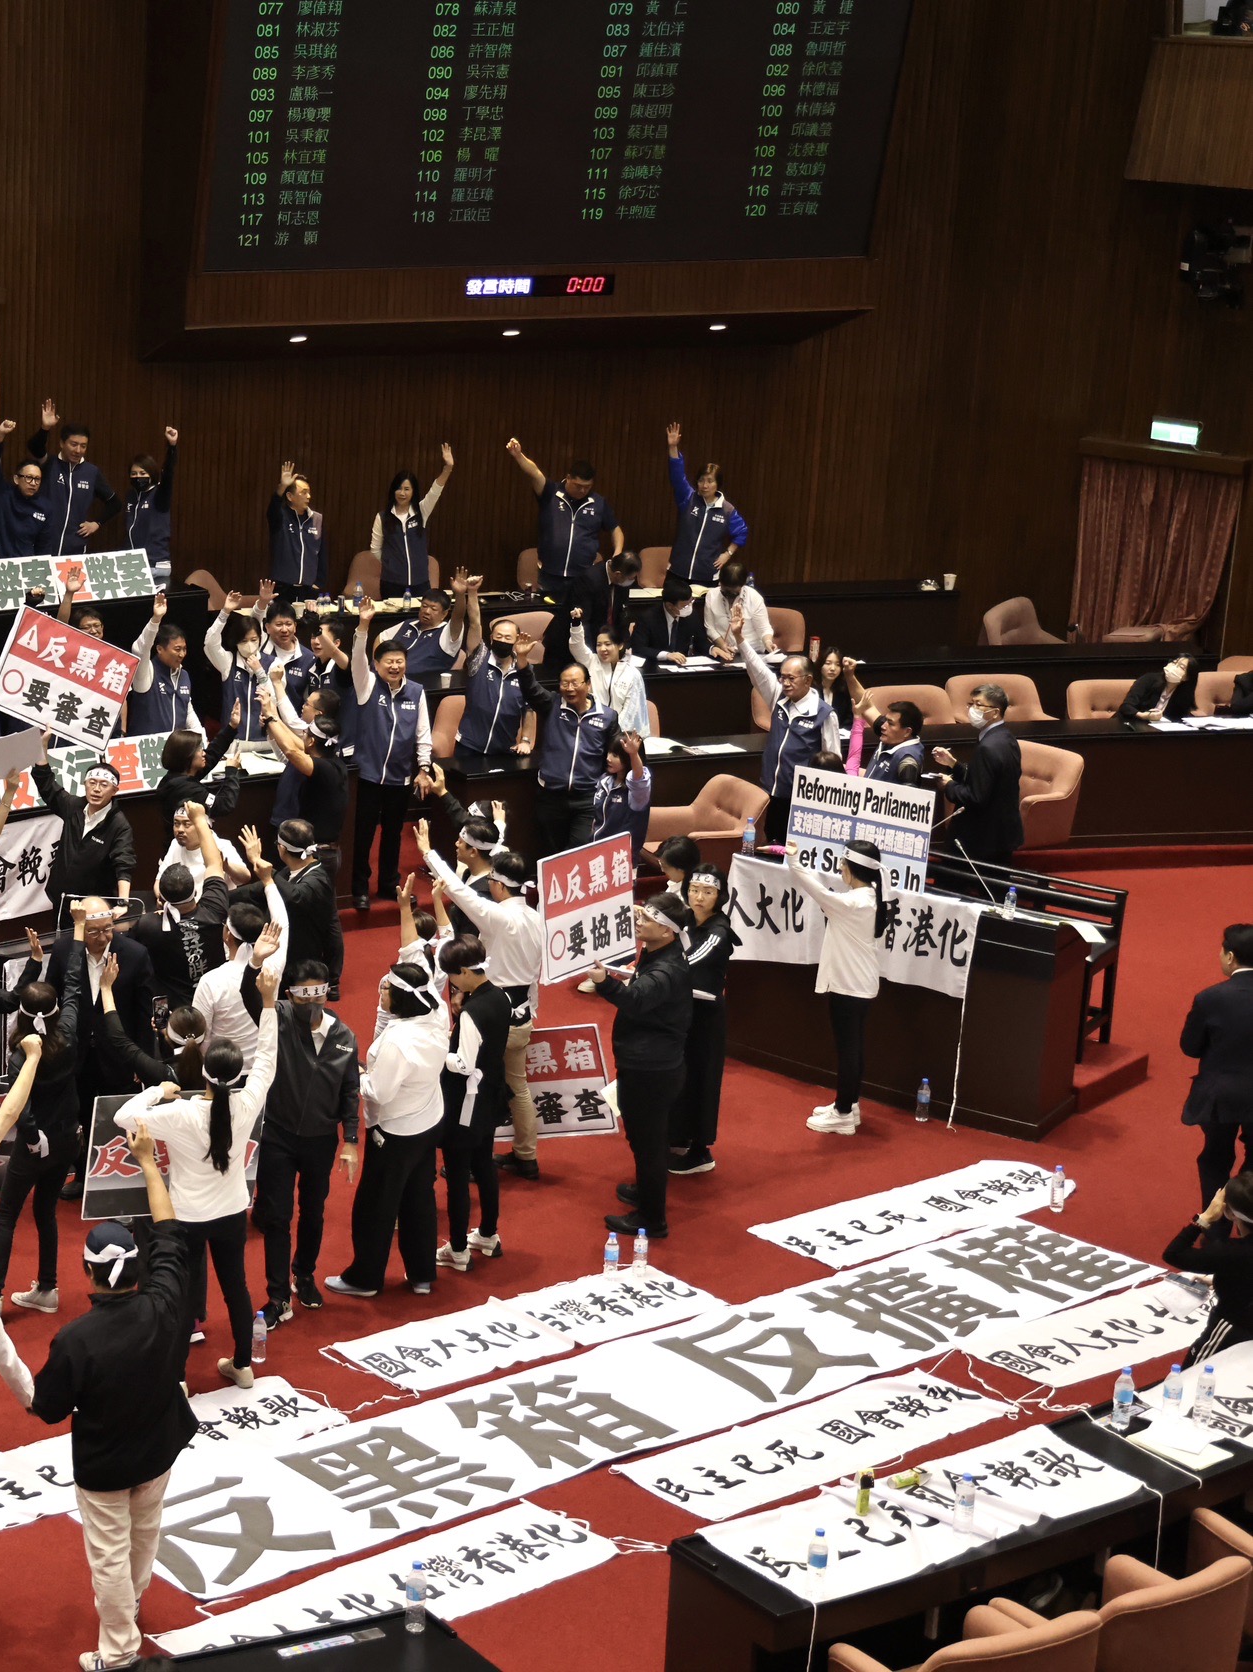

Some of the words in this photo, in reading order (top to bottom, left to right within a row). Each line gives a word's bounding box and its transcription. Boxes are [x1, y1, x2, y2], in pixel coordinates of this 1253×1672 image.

[259, 2, 283, 16] 077
[436, 3, 460, 17] 078
[609, 3, 633, 16] 079
[777, 2, 799, 15] 080
[257, 24, 281, 38] 081
[433, 25, 457, 38] 082
[606, 24, 630, 37] 083
[773, 23, 796, 36] 084
[255, 46, 279, 59] 085
[431, 46, 455, 59] 086
[603, 45, 627, 58] 087
[770, 44, 792, 57] 088
[253, 68, 277, 81] 089
[429, 67, 452, 80] 090
[601, 66, 624, 78] 091
[767, 64, 789, 77] 092
[251, 89, 274, 102] 093
[426, 88, 450, 101] 094
[598, 86, 621, 99] 095
[763, 85, 785, 97] 096
[249, 110, 273, 123] 097
[424, 109, 447, 122] 098
[595, 107, 618, 120] 099
[761, 105, 782, 118] 100
[248, 131, 270, 144] 101
[422, 129, 445, 142] 102
[592, 127, 615, 140] 103
[758, 125, 779, 138] 104
[420, 150, 442, 163] 106
[590, 148, 612, 161] 107
[754, 145, 775, 158] 108
[246, 152, 268, 165] 105
[418, 170, 440, 183] 110
[587, 168, 609, 180] 111
[751, 165, 772, 177] 112
[244, 173, 267, 185] 109
[415, 191, 437, 203] 114
[585, 188, 606, 200] 115
[748, 185, 769, 197] 116
[242, 193, 264, 206] 113
[413, 211, 435, 223] 118
[582, 208, 603, 220] 119
[745, 205, 766, 217] 120
[240, 214, 263, 226] 117
[238, 234, 260, 247] 121
[466, 278, 530, 295] 發言時間
[567, 277, 605, 293] 0:00
[37, 636, 129, 695] 反黑箱
[22, 678, 111, 740] 要審查
[797, 774, 861, 815] Reforming
[864, 787, 931, 824] Parliament
[792, 810, 852, 841] 支持國會改革
[565, 848, 630, 904] 反黑箱
[727, 883, 804, 935] 人大化
[567, 905, 633, 960] 要協商
[783, 1210, 926, 1255] 民主已死
[923, 1168, 1051, 1213] 國會輓歌
[652, 1439, 824, 1503] 民主已死
[816, 1382, 982, 1445] 國會輓歌
